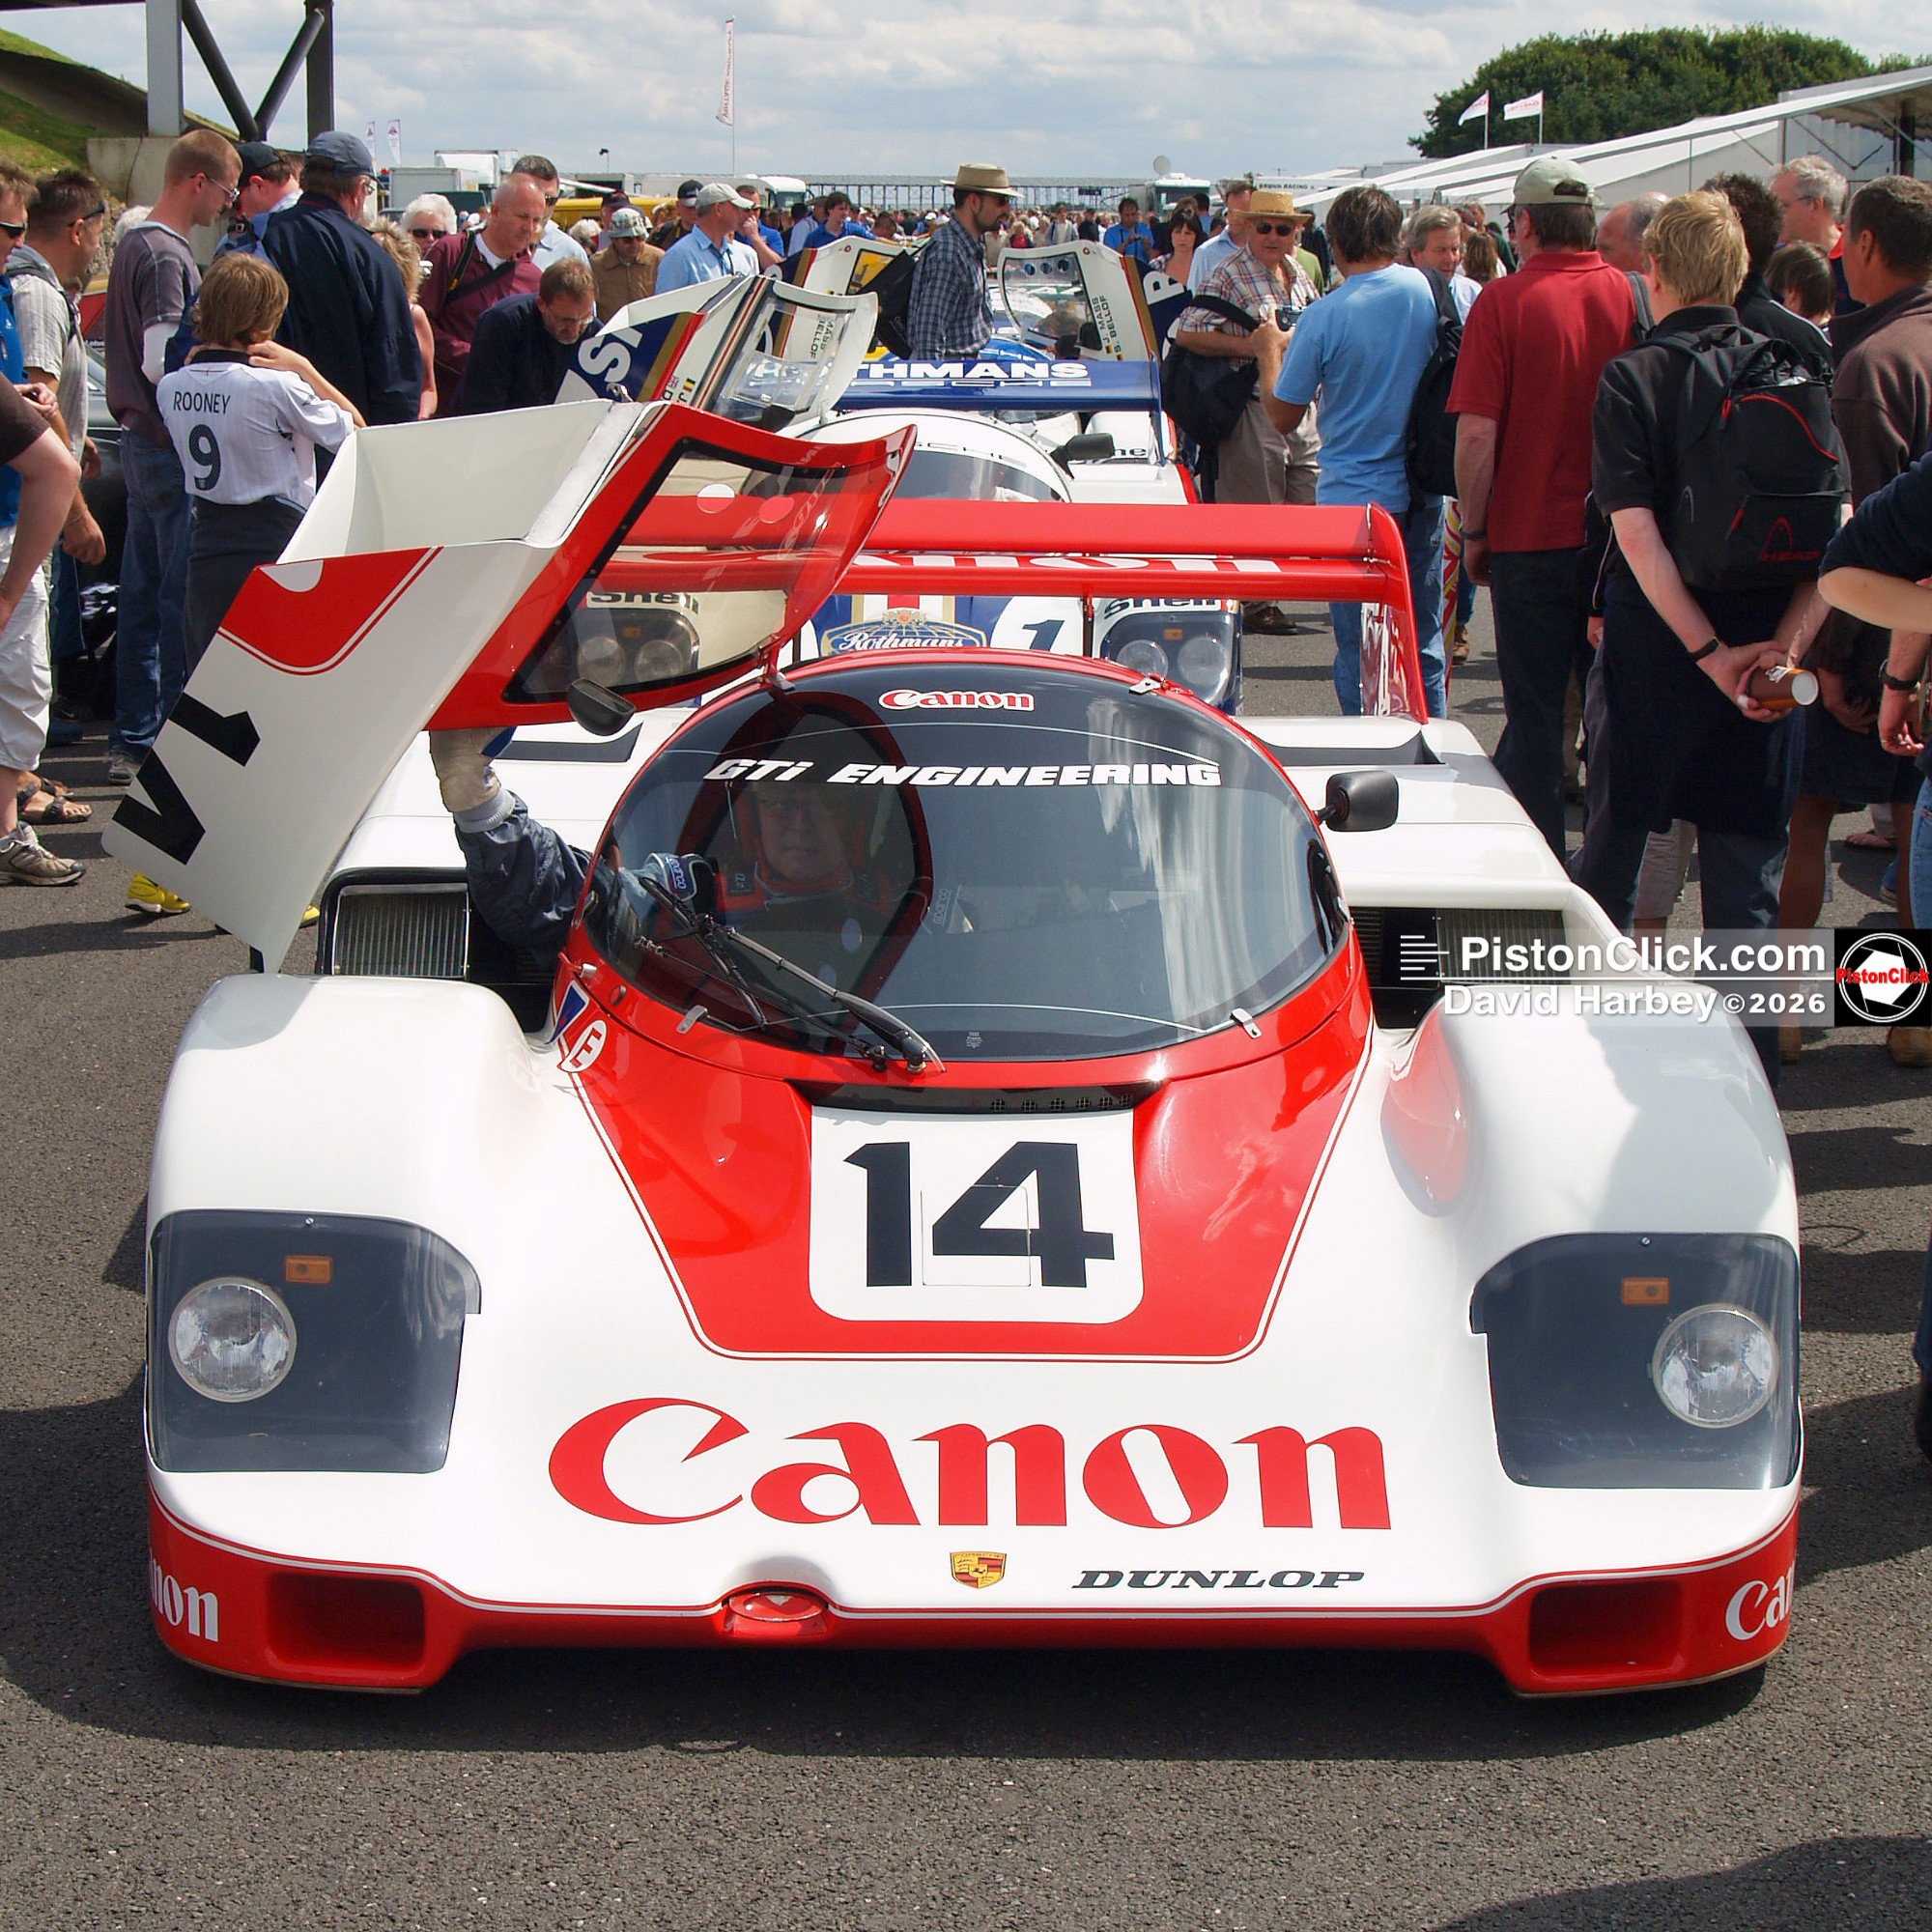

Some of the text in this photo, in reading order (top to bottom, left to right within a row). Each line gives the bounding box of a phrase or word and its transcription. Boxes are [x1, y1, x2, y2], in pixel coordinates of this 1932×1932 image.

[1092, 297, 1106, 329] MASS
[1099, 295, 1117, 338] BELLOF
[173, 390, 231, 414] ROONEY
[189, 423, 221, 491] 9
[838, 631, 964, 651] Rothmans
[1023, 619, 1065, 652] 1
[880, 691, 1034, 710] Canon
[704, 758, 1221, 786] GTi ENGINEERING
[570, 1028, 602, 1068] E
[843, 1142, 1114, 1288] 14
[549, 1398, 1390, 1529] Canon
[1072, 1570, 1365, 1588] DUNLOP
[151, 1553, 218, 1642] non
